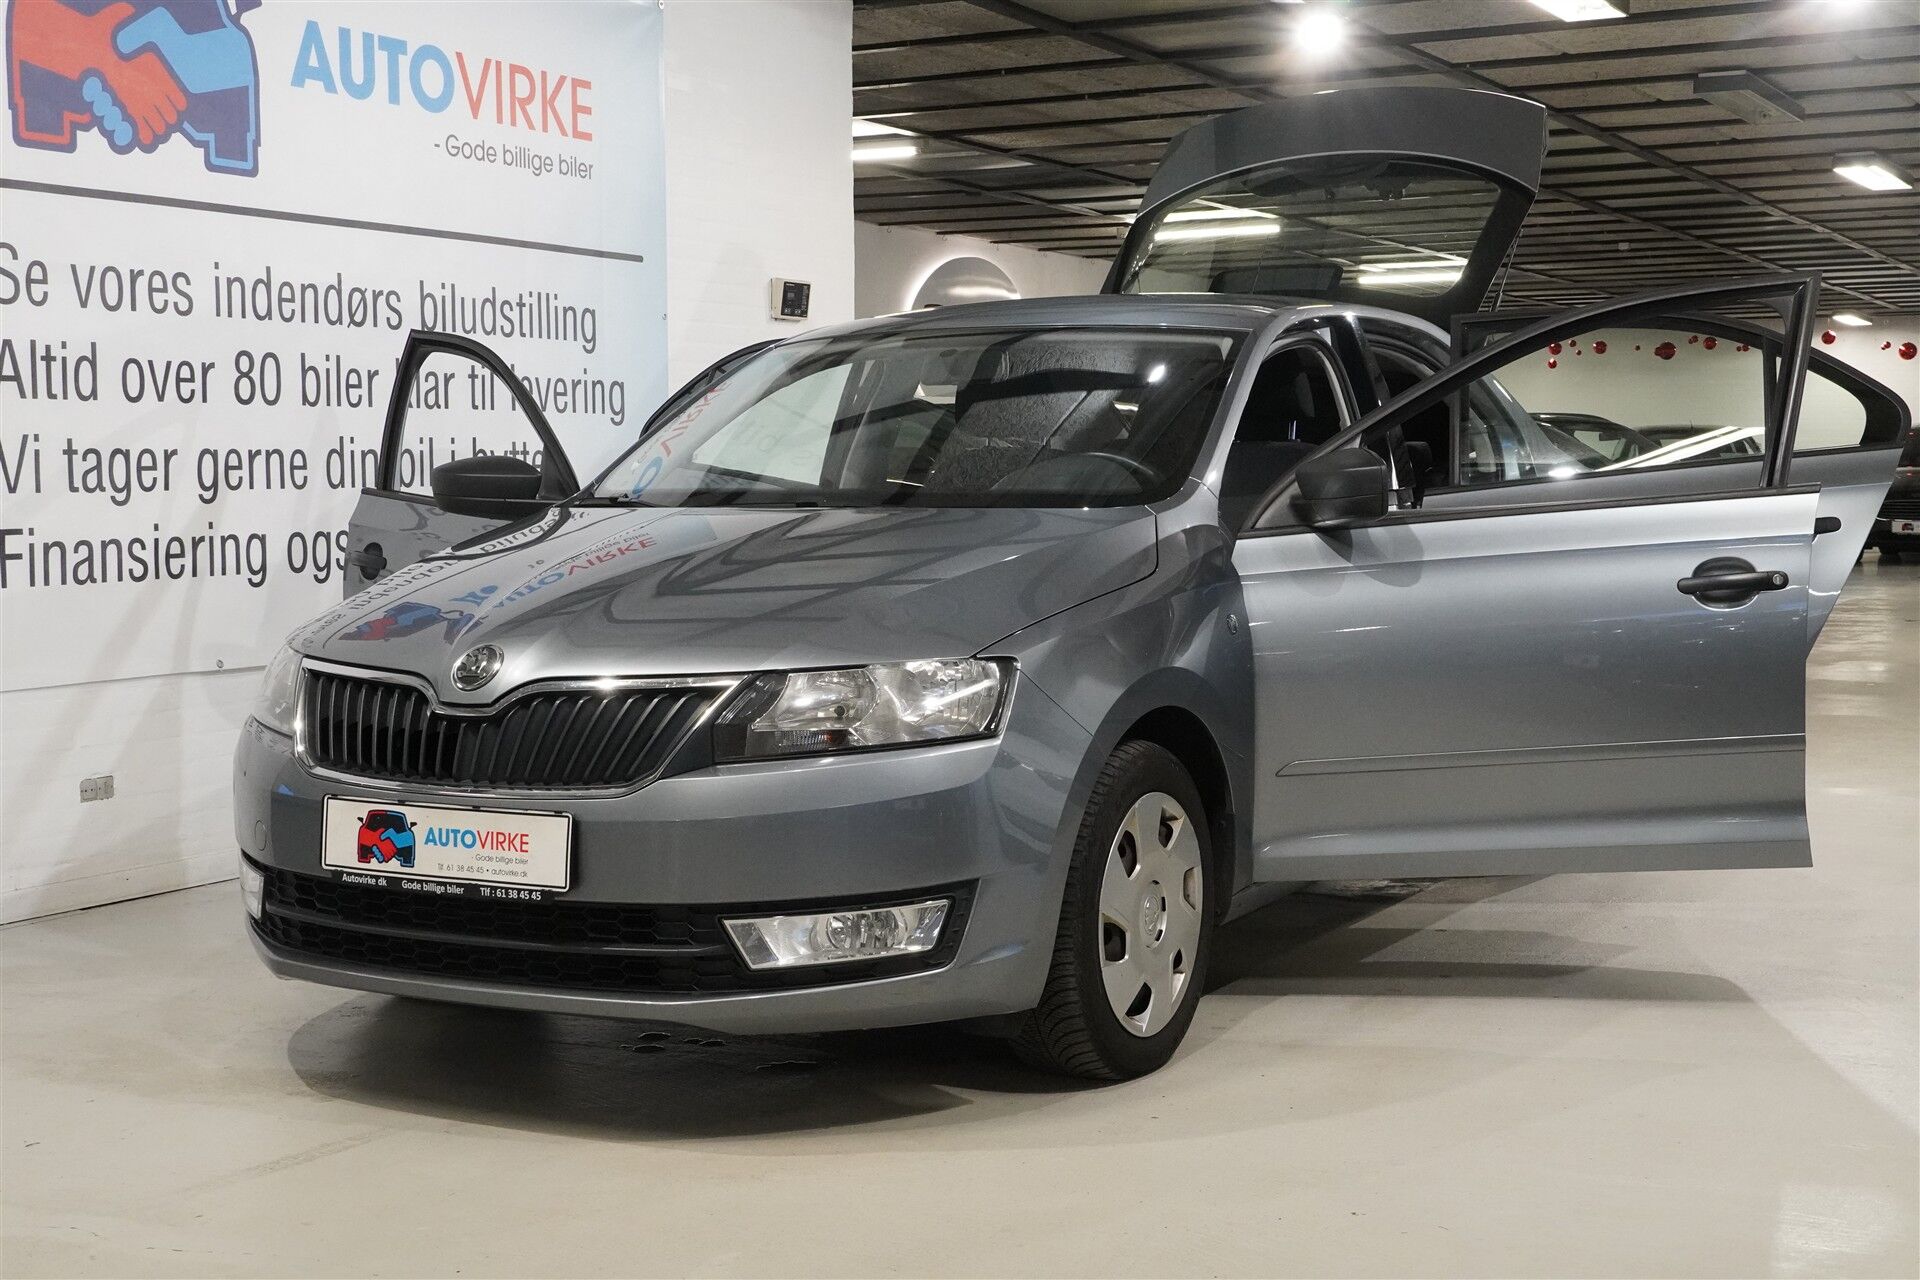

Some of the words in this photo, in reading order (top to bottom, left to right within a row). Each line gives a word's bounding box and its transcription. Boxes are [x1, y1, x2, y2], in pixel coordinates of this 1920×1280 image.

[290, 19, 593, 142] AUTOVIRKE
[445, 134, 497, 163] Gode
[503, 144, 553, 176] billige
[559, 154, 594, 180] biler
[0, 242, 49, 307] Se
[70, 263, 194, 317] vores
[214, 262, 403, 330] indendørs
[419, 280, 597, 354] biludstilling
[0, 339, 99, 402] Altid
[121, 357, 215, 403] over
[233, 350, 281, 406] 80
[301, 353, 379, 408] biler
[468, 364, 495, 411] til
[0, 434, 41, 494] Vi
[62, 438, 178, 507] tager
[197, 448, 308, 505] gerne
[326, 435, 380, 489] din
[0, 521, 267, 588] Finansiering
[424, 827, 529, 853] AUTOVIRKE
[475, 854, 494, 863] Gode
[342, 873, 376, 886] Autovirke
[378, 878, 387, 887] dk
[402, 880, 421, 890] Gode
[423, 882, 445, 894] billige
[447, 885, 464, 895] biler
[480, 887, 490, 897] Tlf
[496, 888, 506, 898] 61
[508, 889, 518, 899] 38
[519, 890, 529, 900] 45
[531, 891, 541, 901] 45
[466, 865, 475, 873] 45
